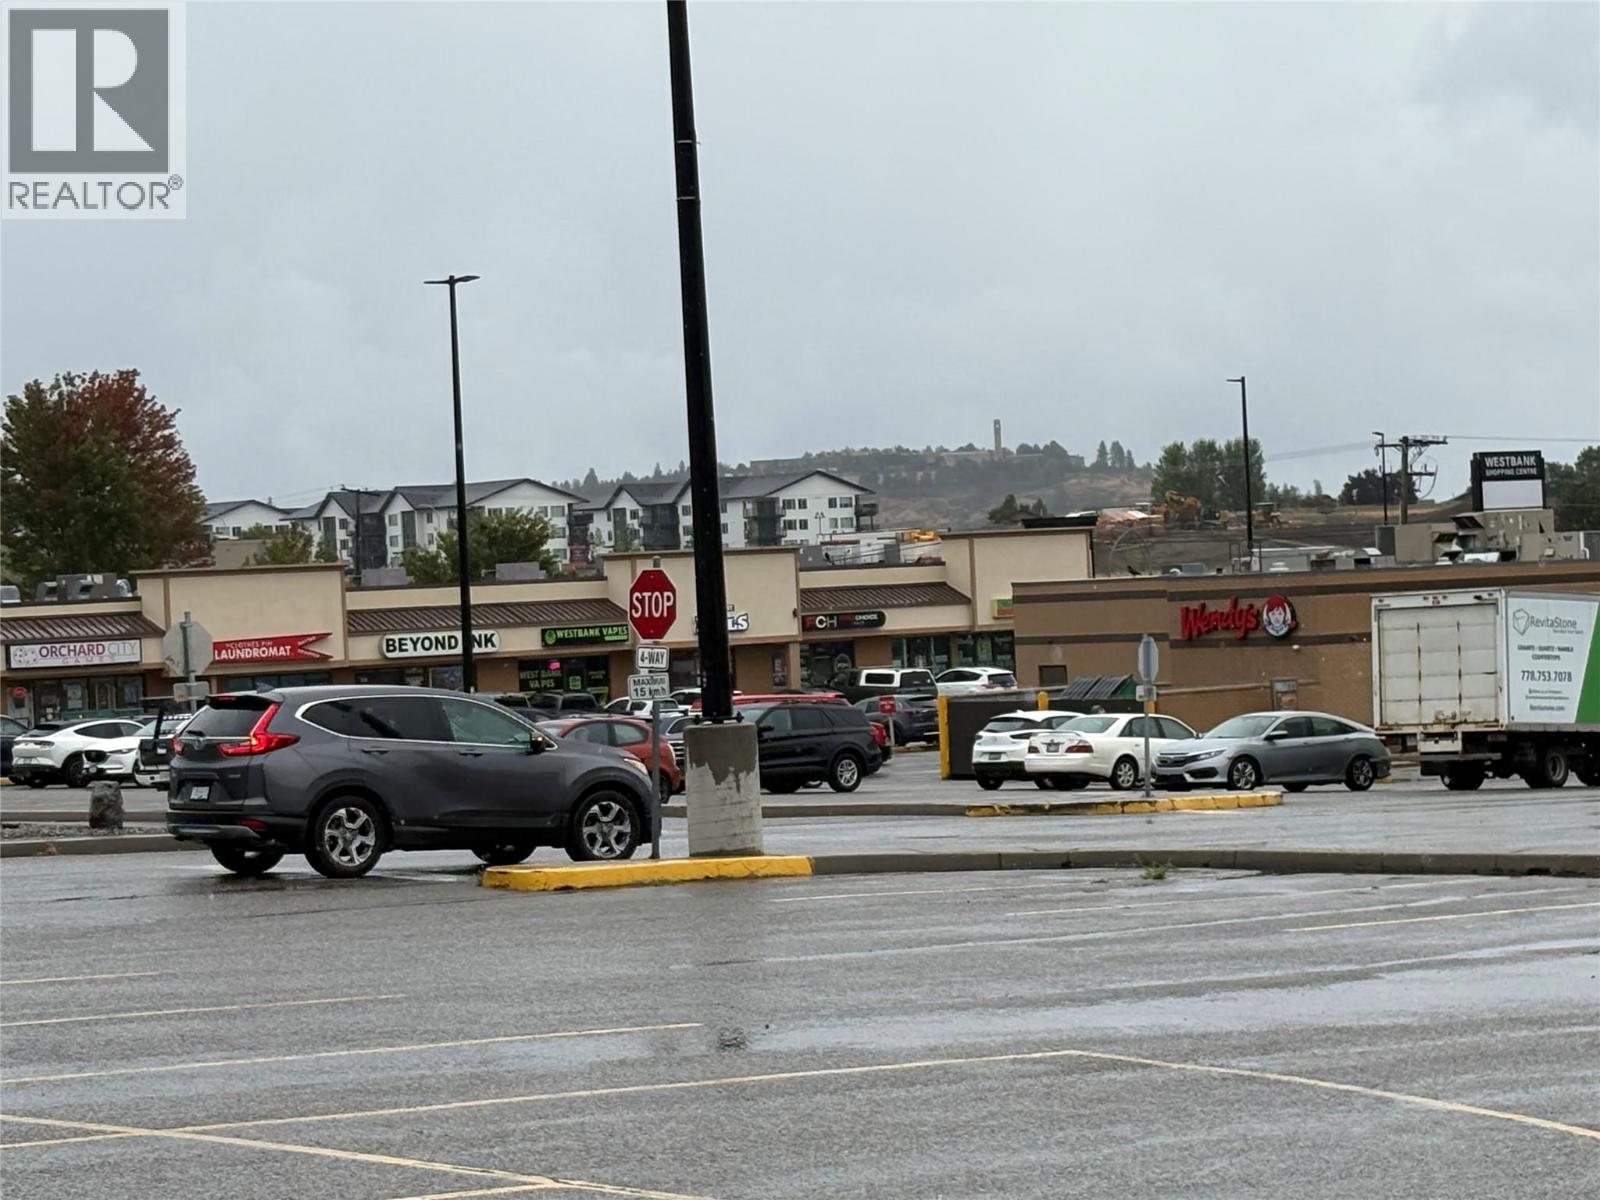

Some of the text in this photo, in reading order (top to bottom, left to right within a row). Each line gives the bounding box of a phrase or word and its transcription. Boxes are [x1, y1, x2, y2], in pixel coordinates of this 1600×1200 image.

[1485, 456, 1536, 467] WESTBANK
[1486, 468, 1514, 476] SHOPPING
[631, 591, 674, 618] STOP
[1179, 597, 1260, 640] Wendy's
[1530, 616, 1577, 629] RevitaStone
[556, 628, 600, 638] WESTBANK
[602, 626, 627, 635] VAPES
[38, 642, 138, 658] ORCHARD CITY
[385, 633, 497, 653] BEYOND NK
[214, 646, 291, 660] LAUNDROMAT
[640, 650, 665, 664] 4-WAY
[633, 687, 646, 697] 15
